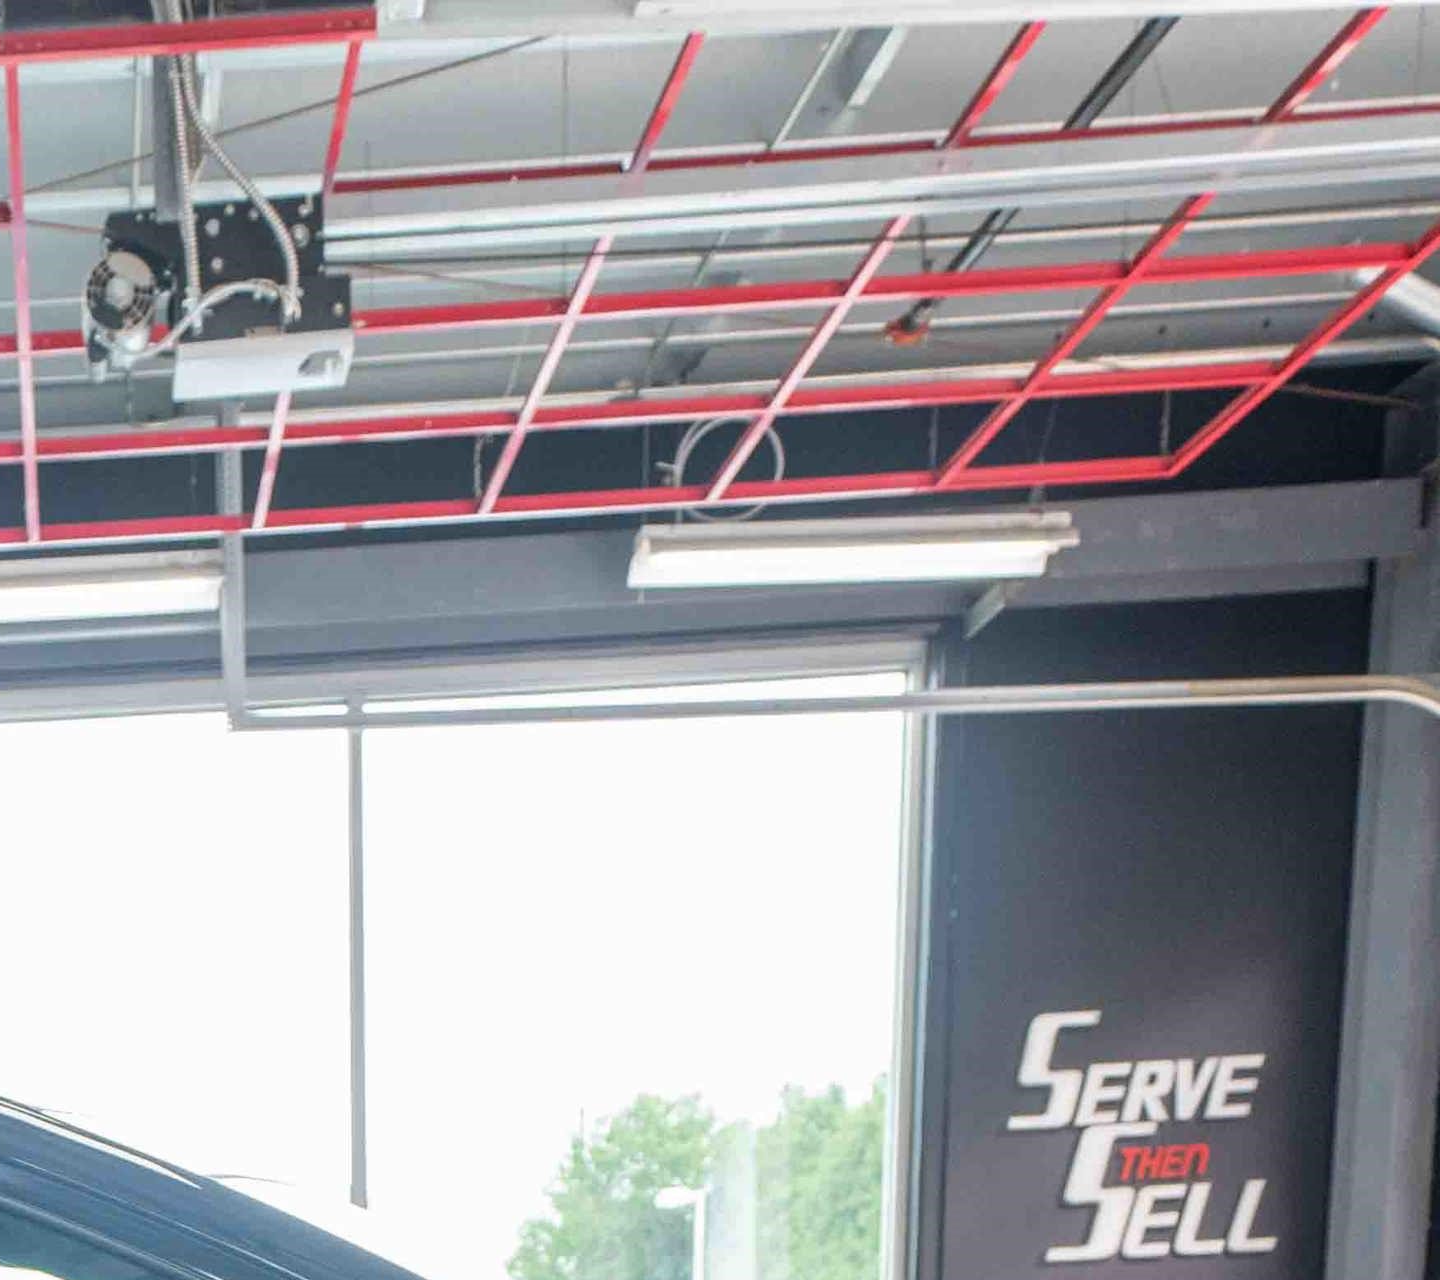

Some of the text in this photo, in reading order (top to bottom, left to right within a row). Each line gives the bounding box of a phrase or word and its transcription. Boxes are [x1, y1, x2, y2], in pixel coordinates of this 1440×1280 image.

[1007, 1010, 1266, 1131] SERVE
[1045, 1122, 1278, 1263] SELL
[1120, 1143, 1210, 1182] THEN
